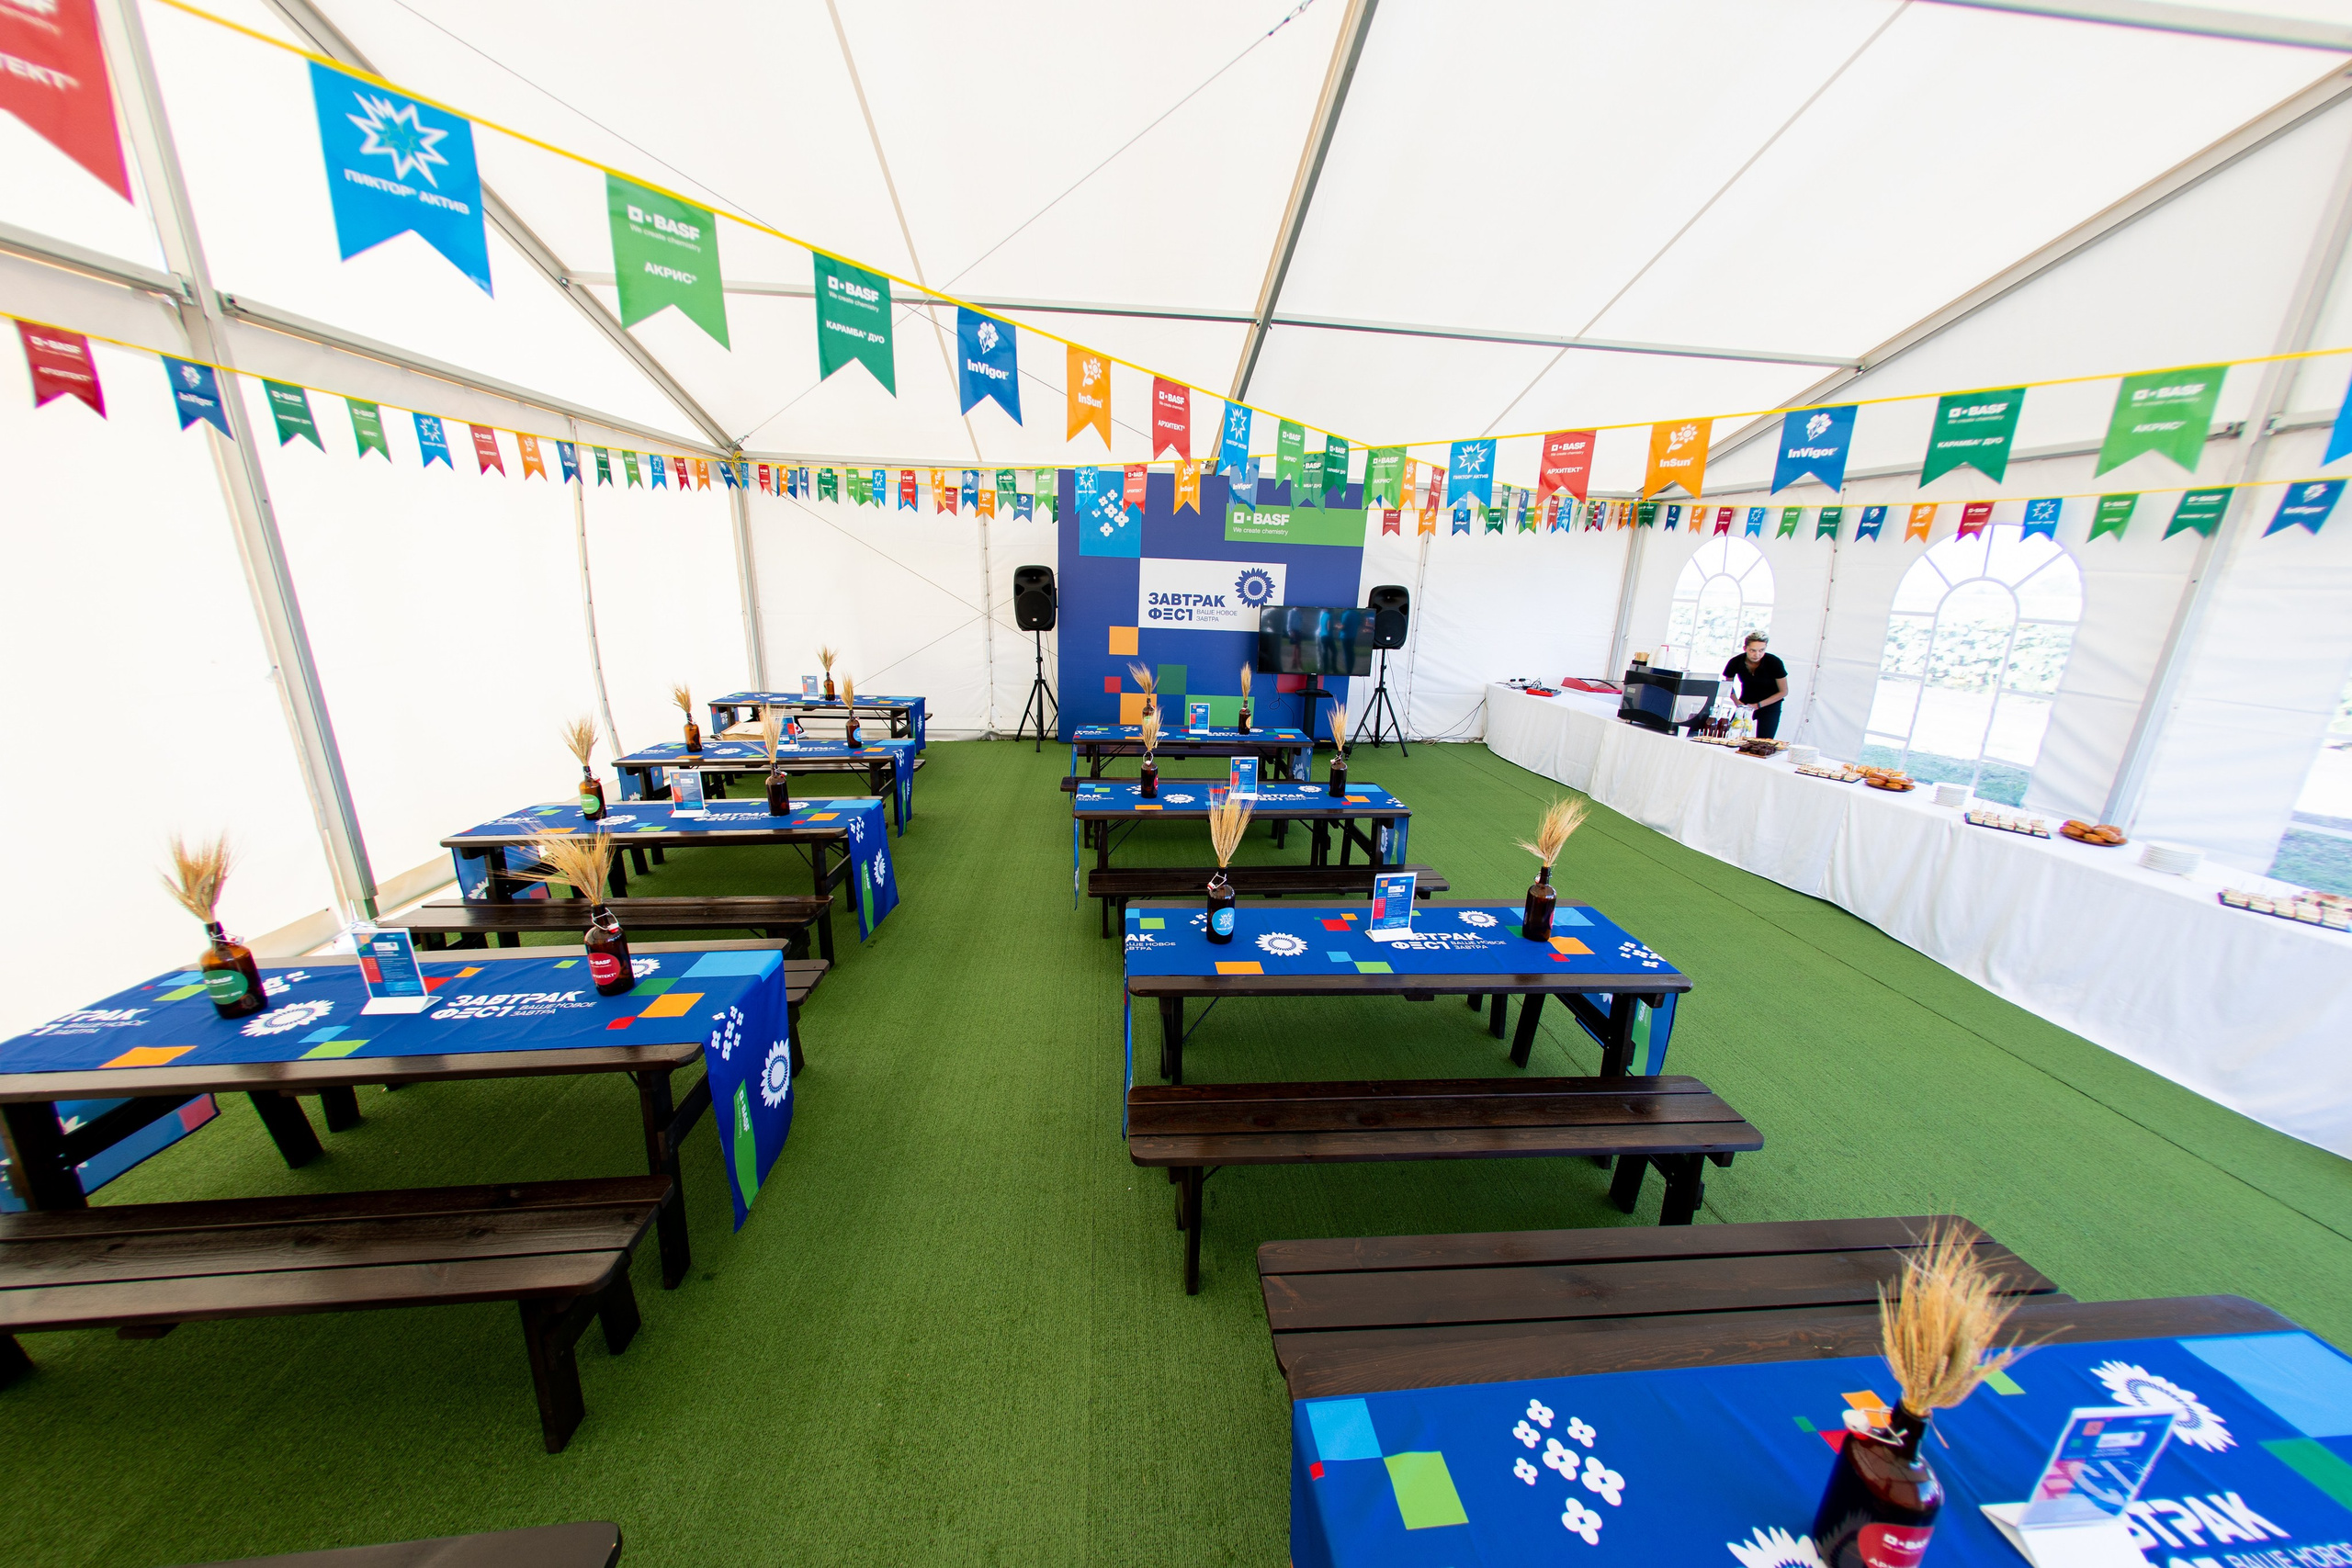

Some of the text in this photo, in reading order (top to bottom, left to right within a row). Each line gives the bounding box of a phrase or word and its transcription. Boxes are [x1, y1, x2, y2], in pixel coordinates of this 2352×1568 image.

[419, 190, 470, 215] АКТИВ
[653, 212, 701, 241] BASF
[845, 281, 879, 303] BASF
[867, 332, 885, 344] ДУО
[2157, 383, 2206, 398] BASF
[1168, 393, 1184, 405] BASF
[1968, 402, 2008, 416] BASF
[1563, 442, 1586, 450] BASF
[1253, 513, 1290, 525] BASF
[1148, 592, 1226, 607] ЗАВТРАК
[447, 990, 585, 1007] ЗАВТРАК
[509, 1009, 557, 1017] ЗАВТРА
[741, 1103, 750, 1132] BASF
